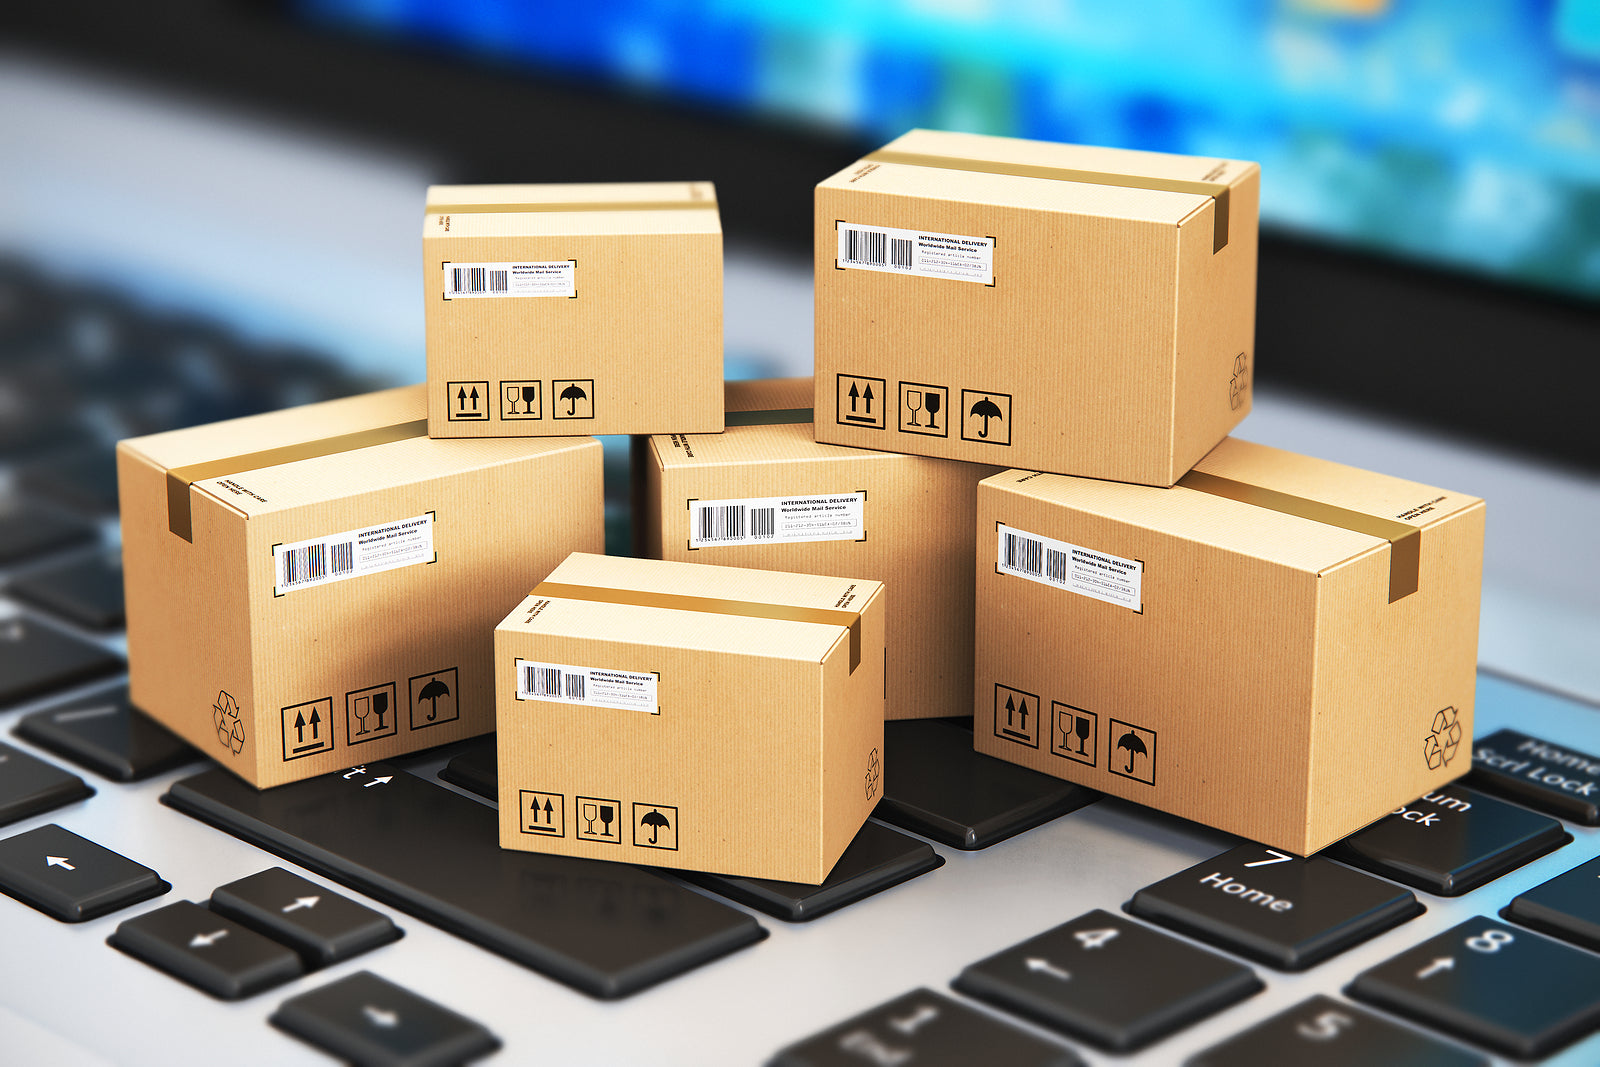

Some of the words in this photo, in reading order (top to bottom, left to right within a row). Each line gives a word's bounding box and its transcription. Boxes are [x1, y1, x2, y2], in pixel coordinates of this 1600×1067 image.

[918, 236, 960, 244] INTERNATIONAL
[358, 526, 400, 538] INTERNATIONAL
[402, 520, 427, 528] DELIVERY
[359, 536, 385, 544] Worldwide
[1072, 549, 1111, 564] INTERNATIONAL
[1112, 560, 1136, 570] DELIVERY
[1072, 556, 1096, 567] Worldwide
[1108, 566, 1126, 575] Service
[1527, 766, 1598, 796] Lock
[1422, 791, 1472, 812] um
[1244, 849, 1293, 868] 7
[1199, 872, 1293, 912] Home
[1073, 928, 1120, 949] 4
[1465, 929, 1515, 953] 8
[1296, 1011, 1353, 1039] 5
